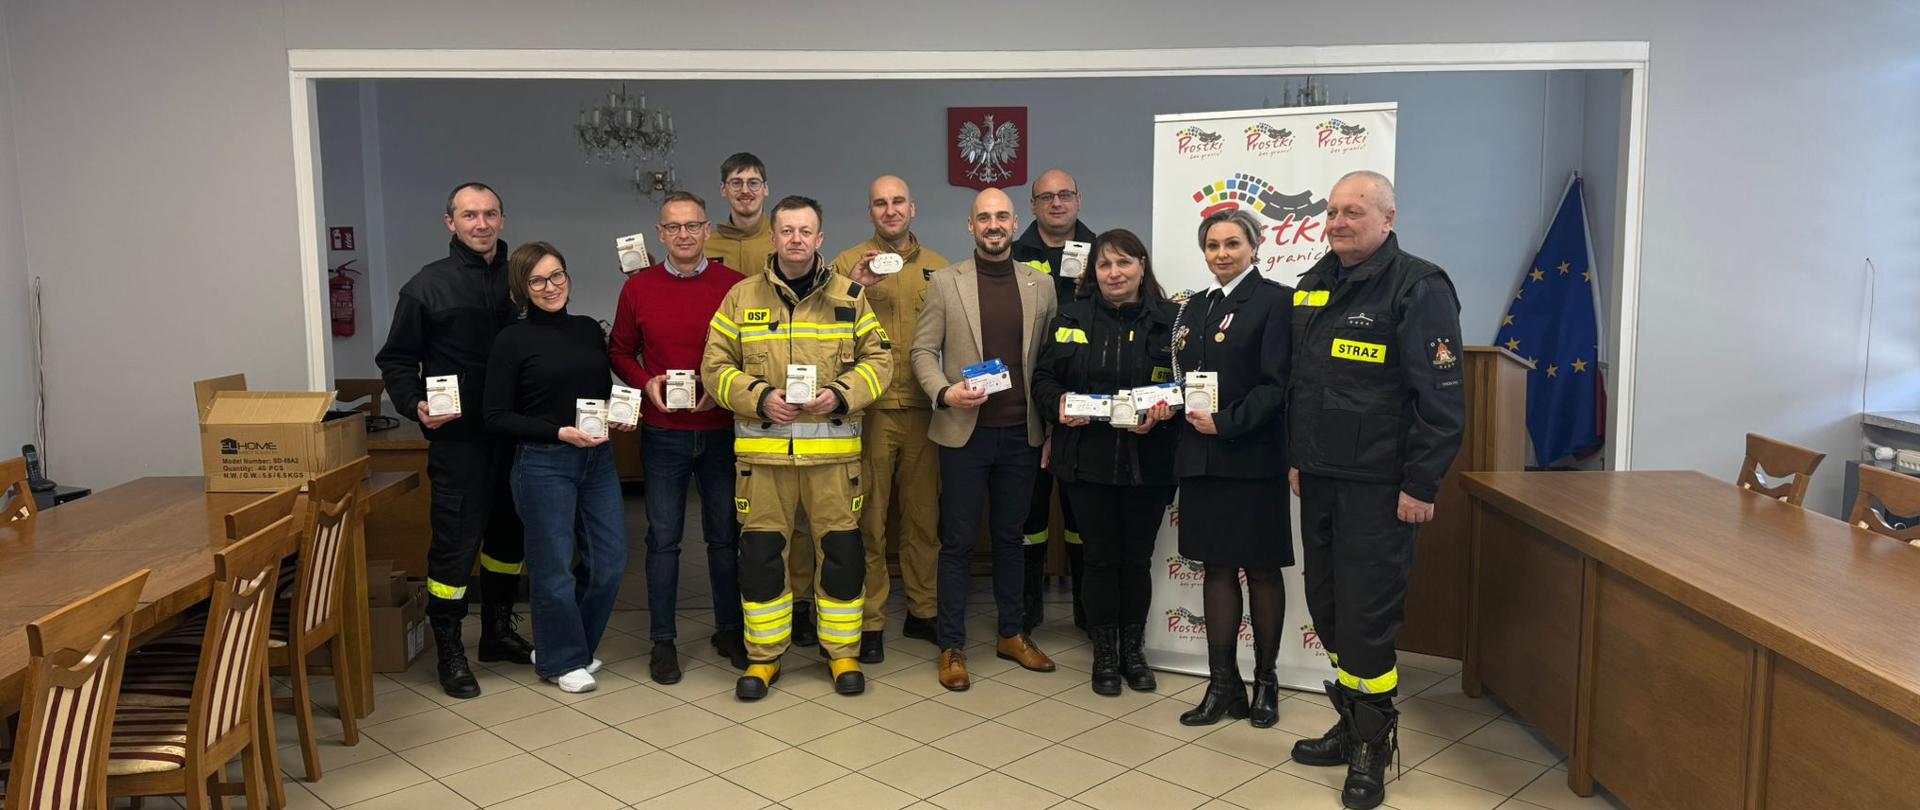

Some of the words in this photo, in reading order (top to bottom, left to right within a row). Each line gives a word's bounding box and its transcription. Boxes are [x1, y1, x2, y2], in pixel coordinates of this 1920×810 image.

[1178, 135, 1225, 154] Prostki
[1246, 132, 1296, 151] Prostki
[1318, 129, 1369, 148] Prostki
[748, 311, 767, 321] OSP
[1168, 616, 1206, 633] Prostk
